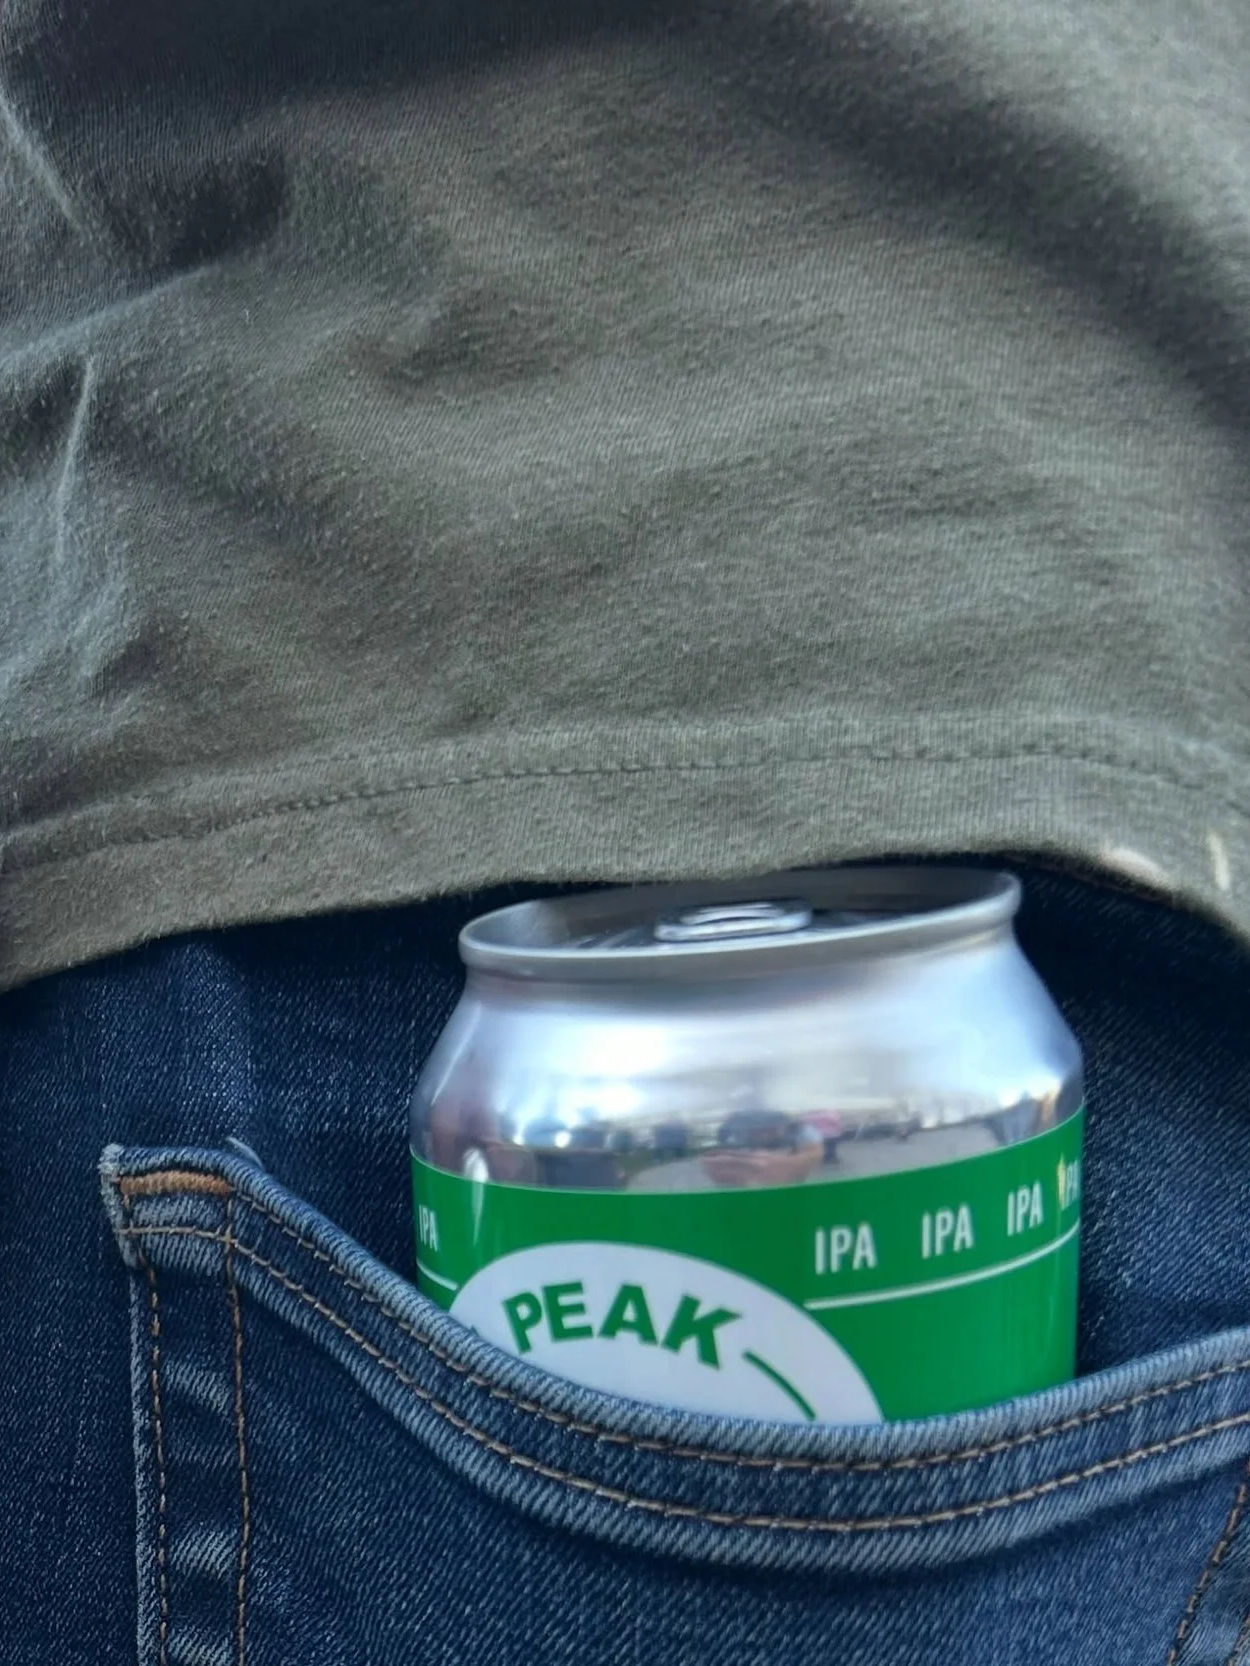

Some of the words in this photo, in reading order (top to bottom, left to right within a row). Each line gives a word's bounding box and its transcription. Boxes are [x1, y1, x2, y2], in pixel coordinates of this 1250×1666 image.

[418, 1203, 439, 1253] IPA
[815, 1222, 877, 1275] IPA
[921, 1203, 974, 1259] IPA
[1007, 1179, 1044, 1236] IPA
[503, 1280, 744, 1370] PEAK
